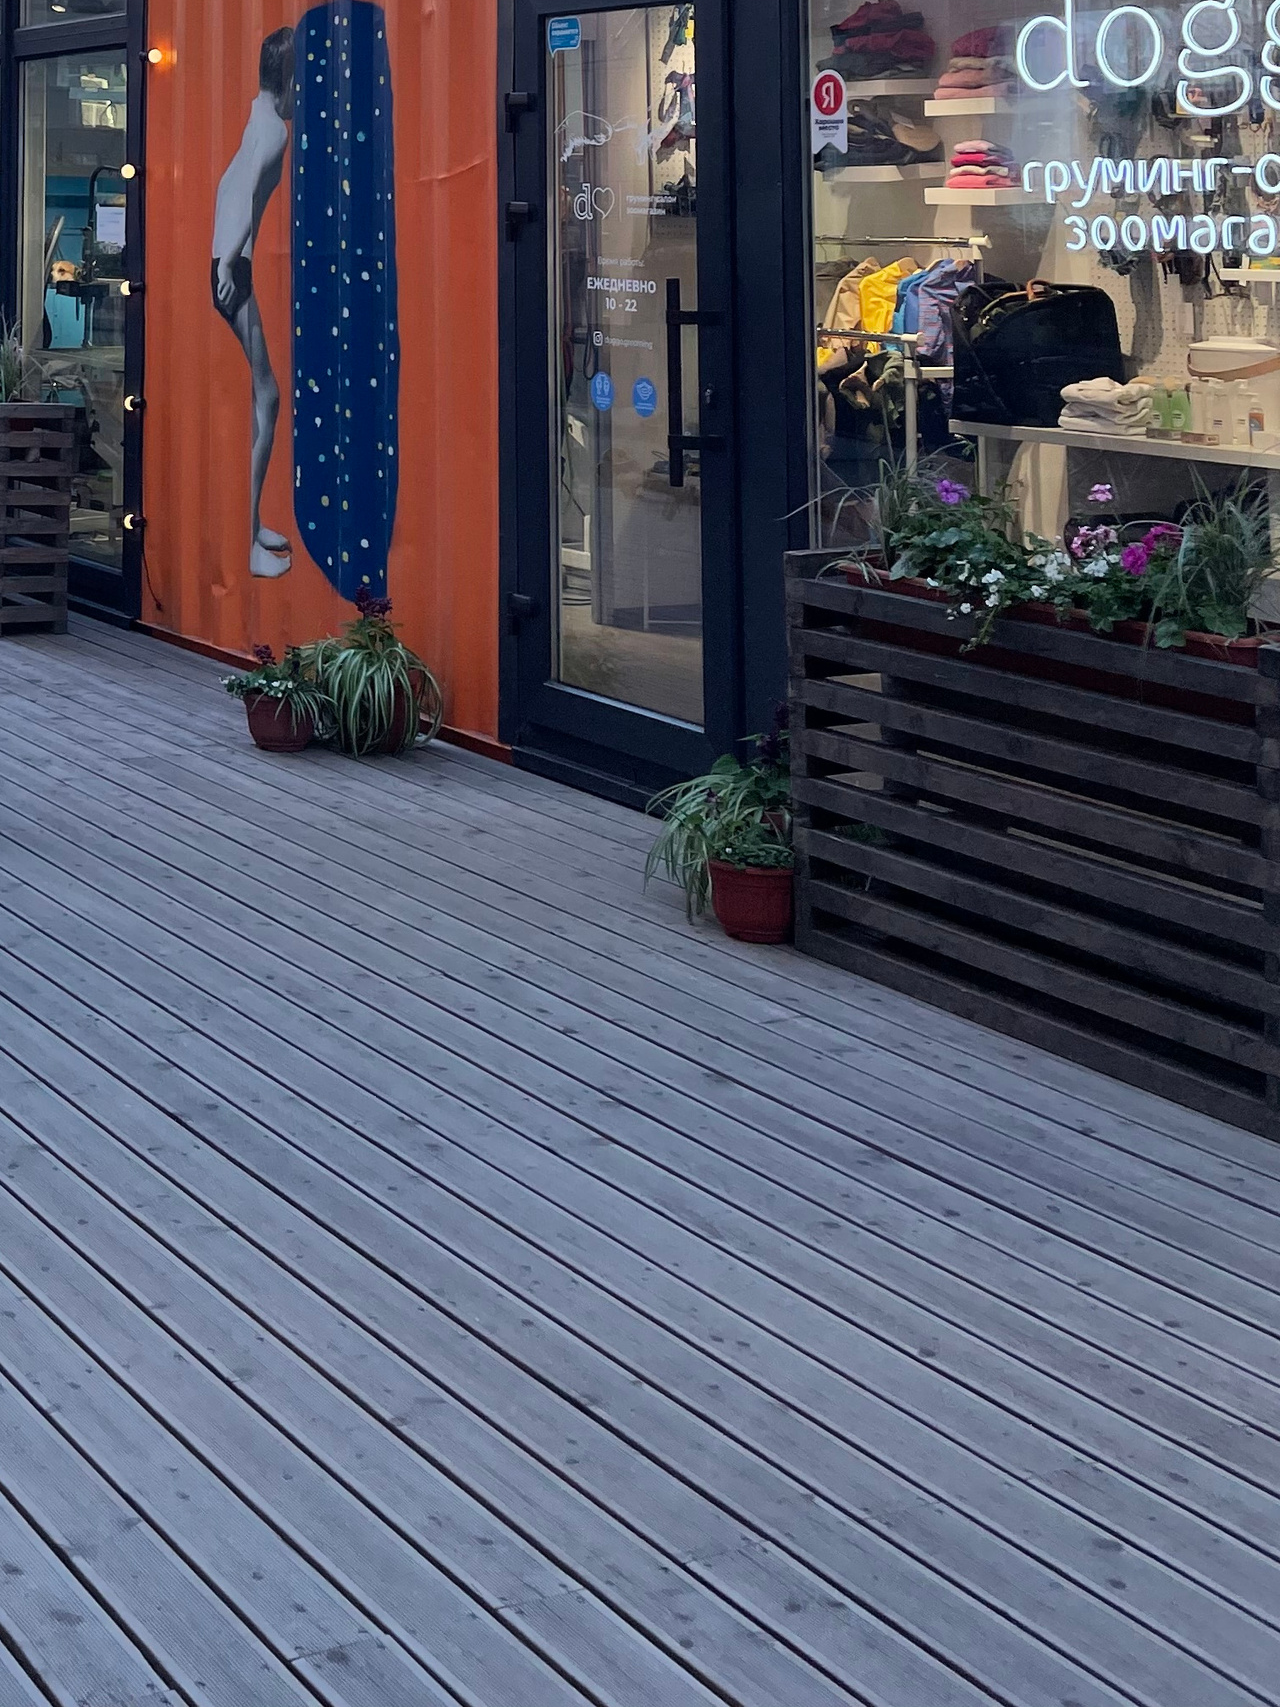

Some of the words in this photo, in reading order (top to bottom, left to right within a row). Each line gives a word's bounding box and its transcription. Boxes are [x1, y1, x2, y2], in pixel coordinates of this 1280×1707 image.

[822, 81, 835, 109] Я
[587, 276, 657, 293] ЕЖЕДНЕВНО
[605, 297, 616, 310] 10
[625, 299, 638, 312] 22
